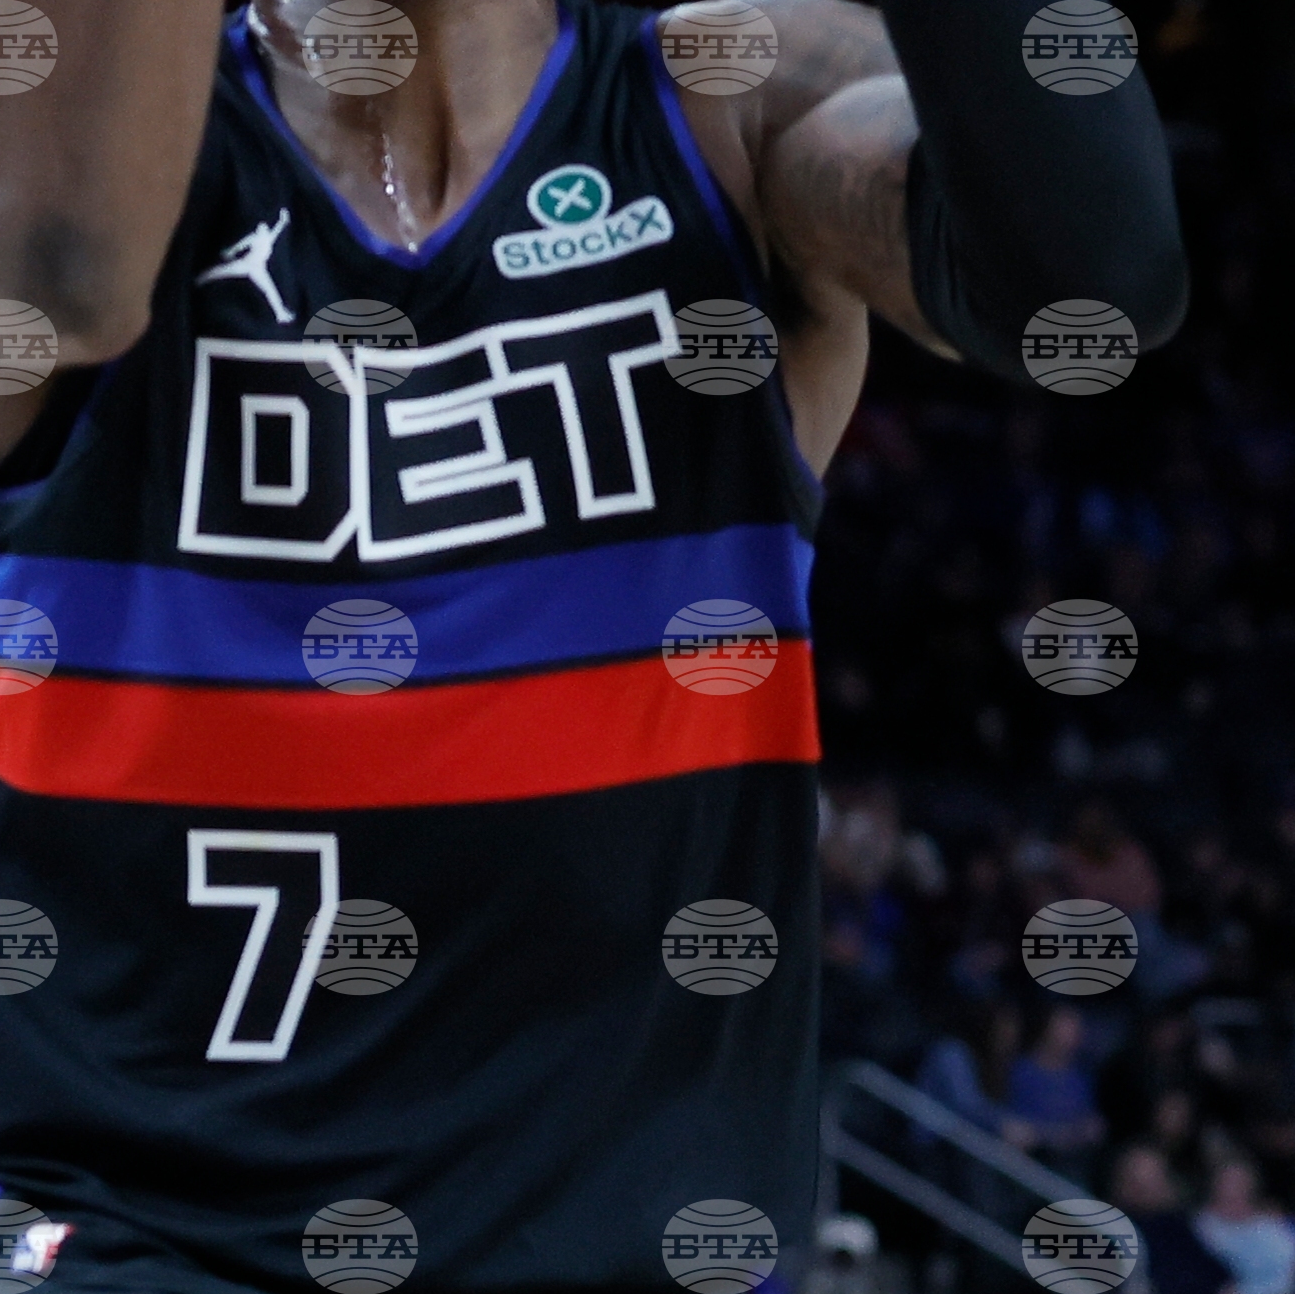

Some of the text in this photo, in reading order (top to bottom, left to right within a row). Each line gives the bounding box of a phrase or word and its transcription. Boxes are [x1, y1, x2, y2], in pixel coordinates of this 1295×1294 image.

[502, 204, 665, 270] StockX
[177, 289, 683, 563] DET
[187, 828, 340, 1063] 7
